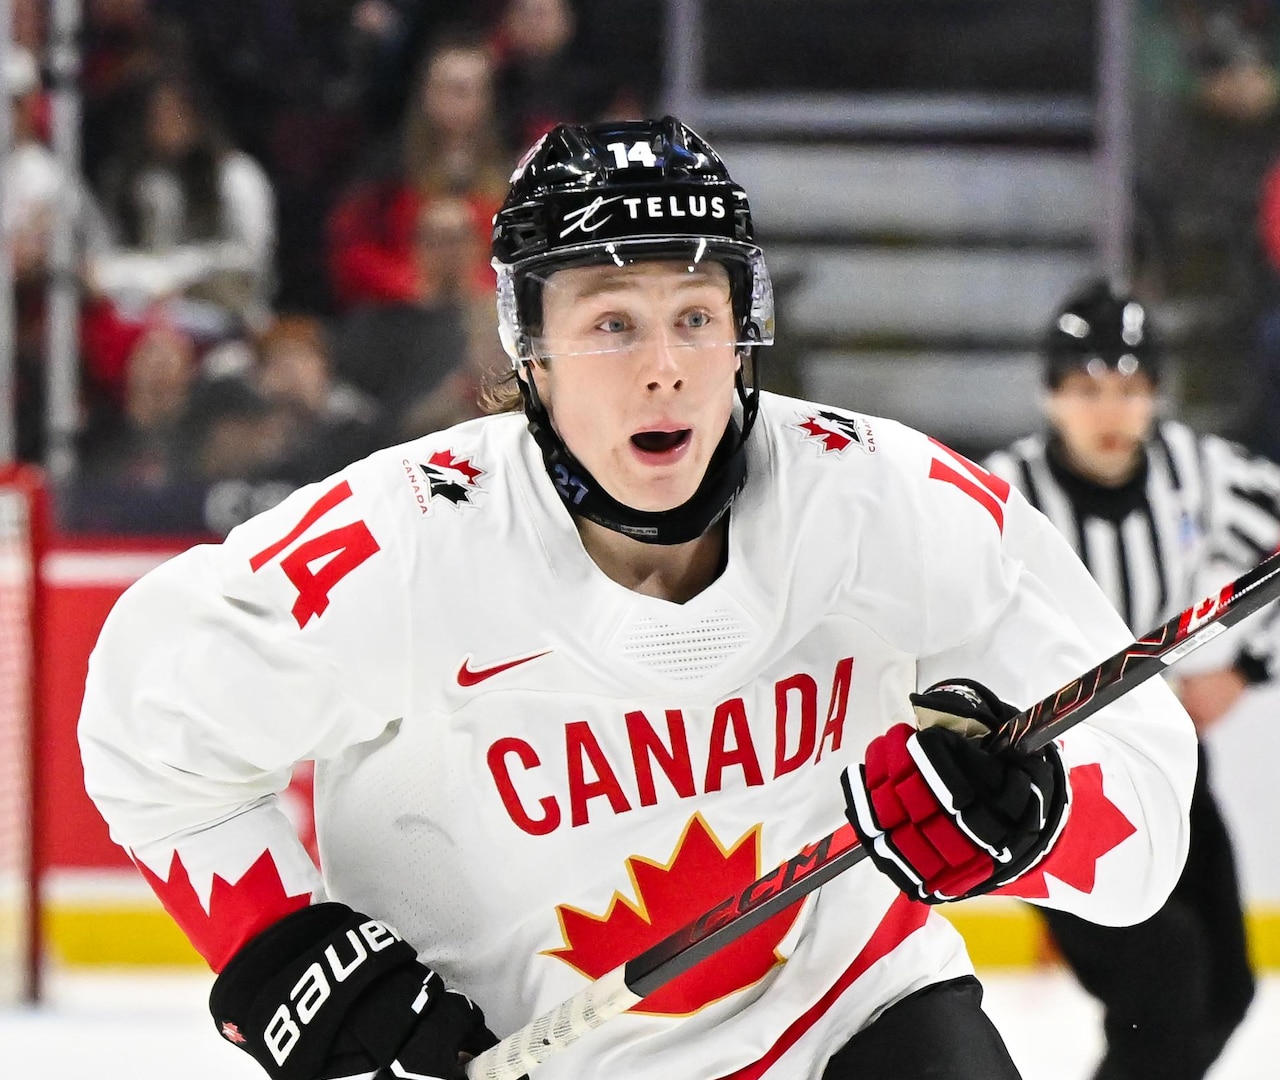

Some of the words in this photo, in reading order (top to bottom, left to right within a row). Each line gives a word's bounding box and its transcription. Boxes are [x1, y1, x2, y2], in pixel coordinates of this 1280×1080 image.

[606, 141, 657, 169] 14
[622, 195, 726, 219] TELUS
[401, 458, 428, 514] CANADA
[248, 479, 381, 630] 14
[486, 656, 855, 837] CANADA
